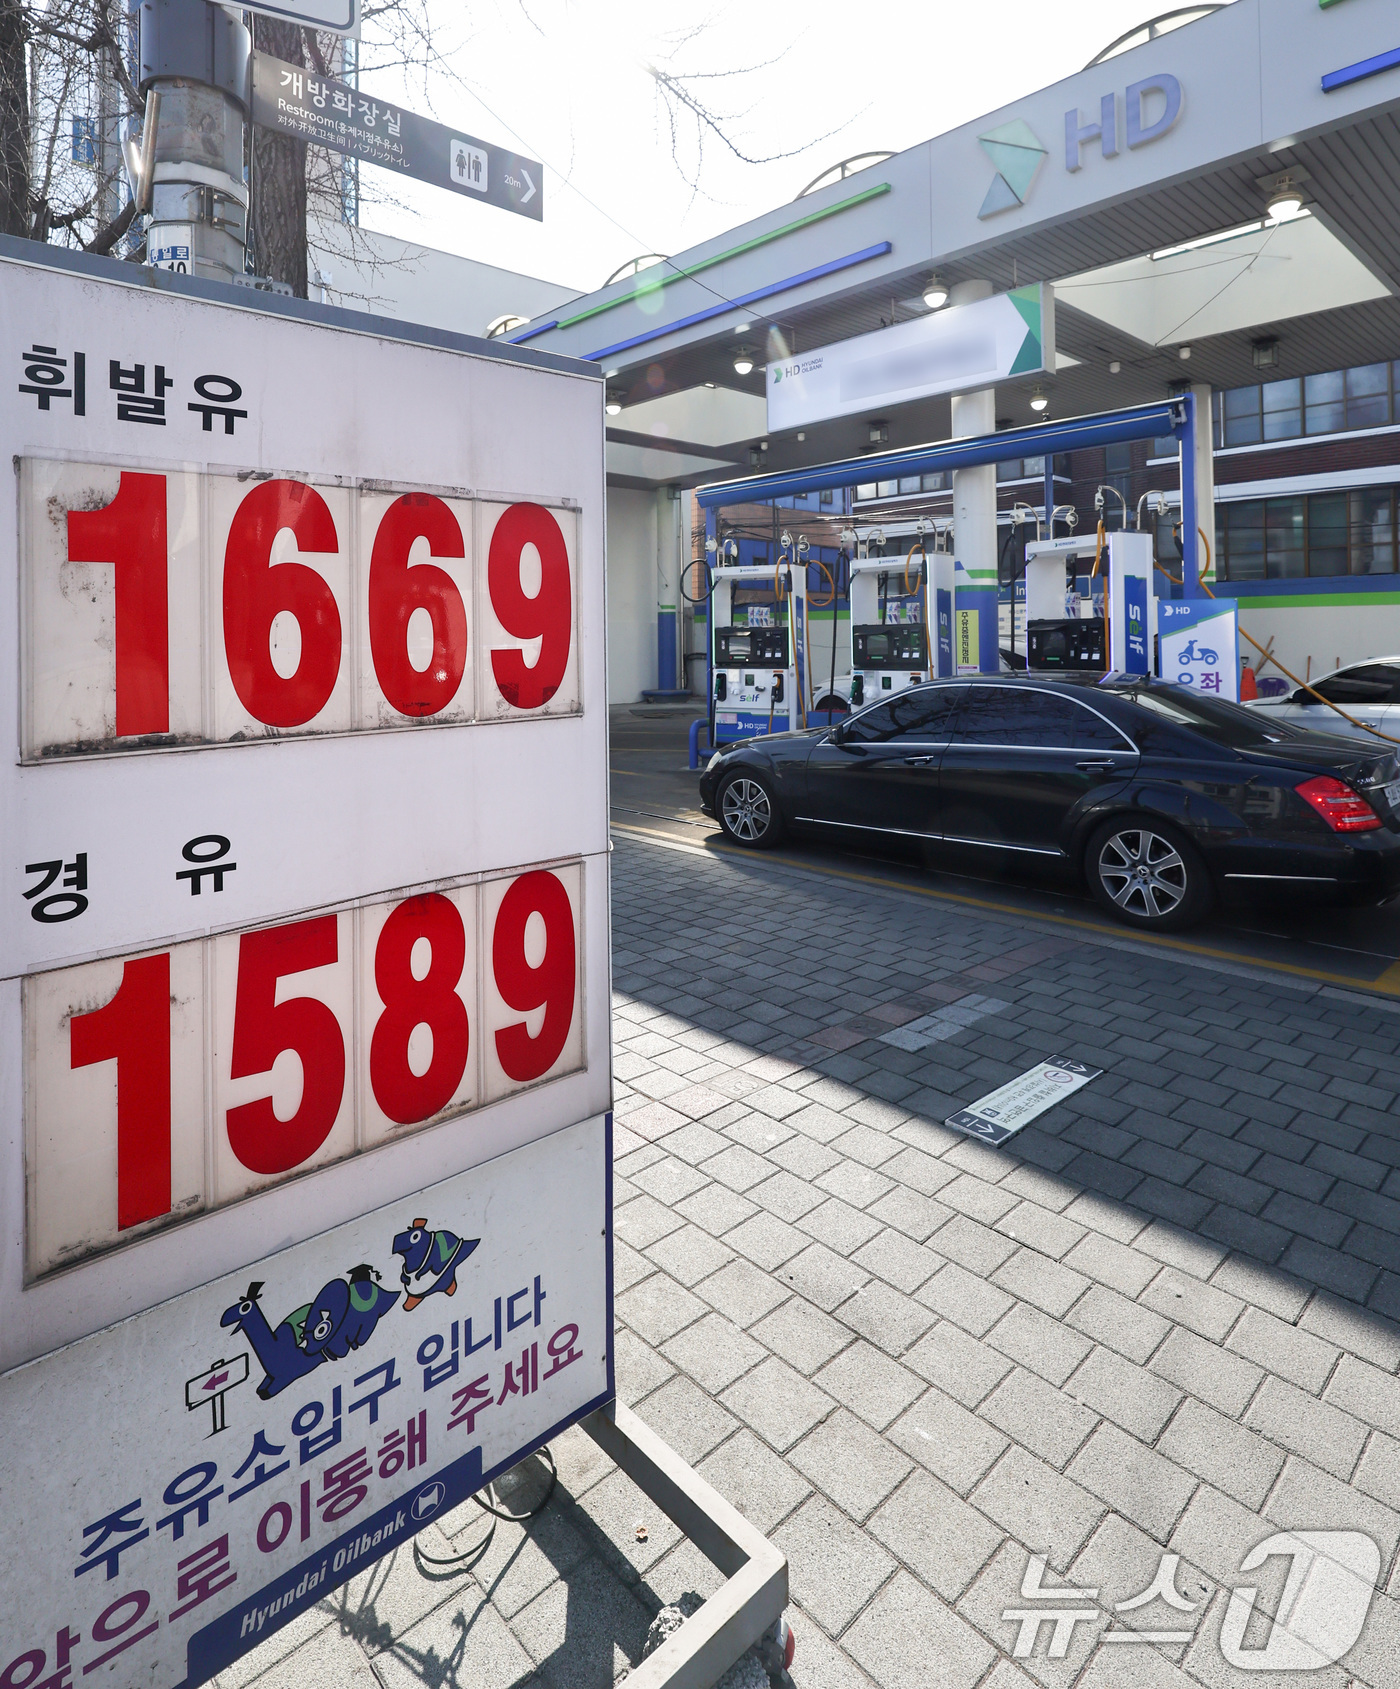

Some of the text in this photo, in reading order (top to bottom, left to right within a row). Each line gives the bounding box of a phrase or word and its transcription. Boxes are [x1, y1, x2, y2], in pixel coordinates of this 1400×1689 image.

[280, 70, 401, 137] 개방화장실
[1065, 73, 1185, 173] HD
[504, 174, 521, 188] 20m
[18, 343, 248, 435] 휘발유
[785, 364, 801, 378] HD
[67, 471, 572, 736] 1669
[1175, 606, 1191, 615] HD
[69, 869, 576, 1232] 1589
[74, 1275, 546, 1580] 주유소입구 입니다
[256, 1409, 428, 1553] 이동해
[446, 1323, 584, 1435] 주세요
[240, 1510, 406, 1638] Hyundai Oilbank
